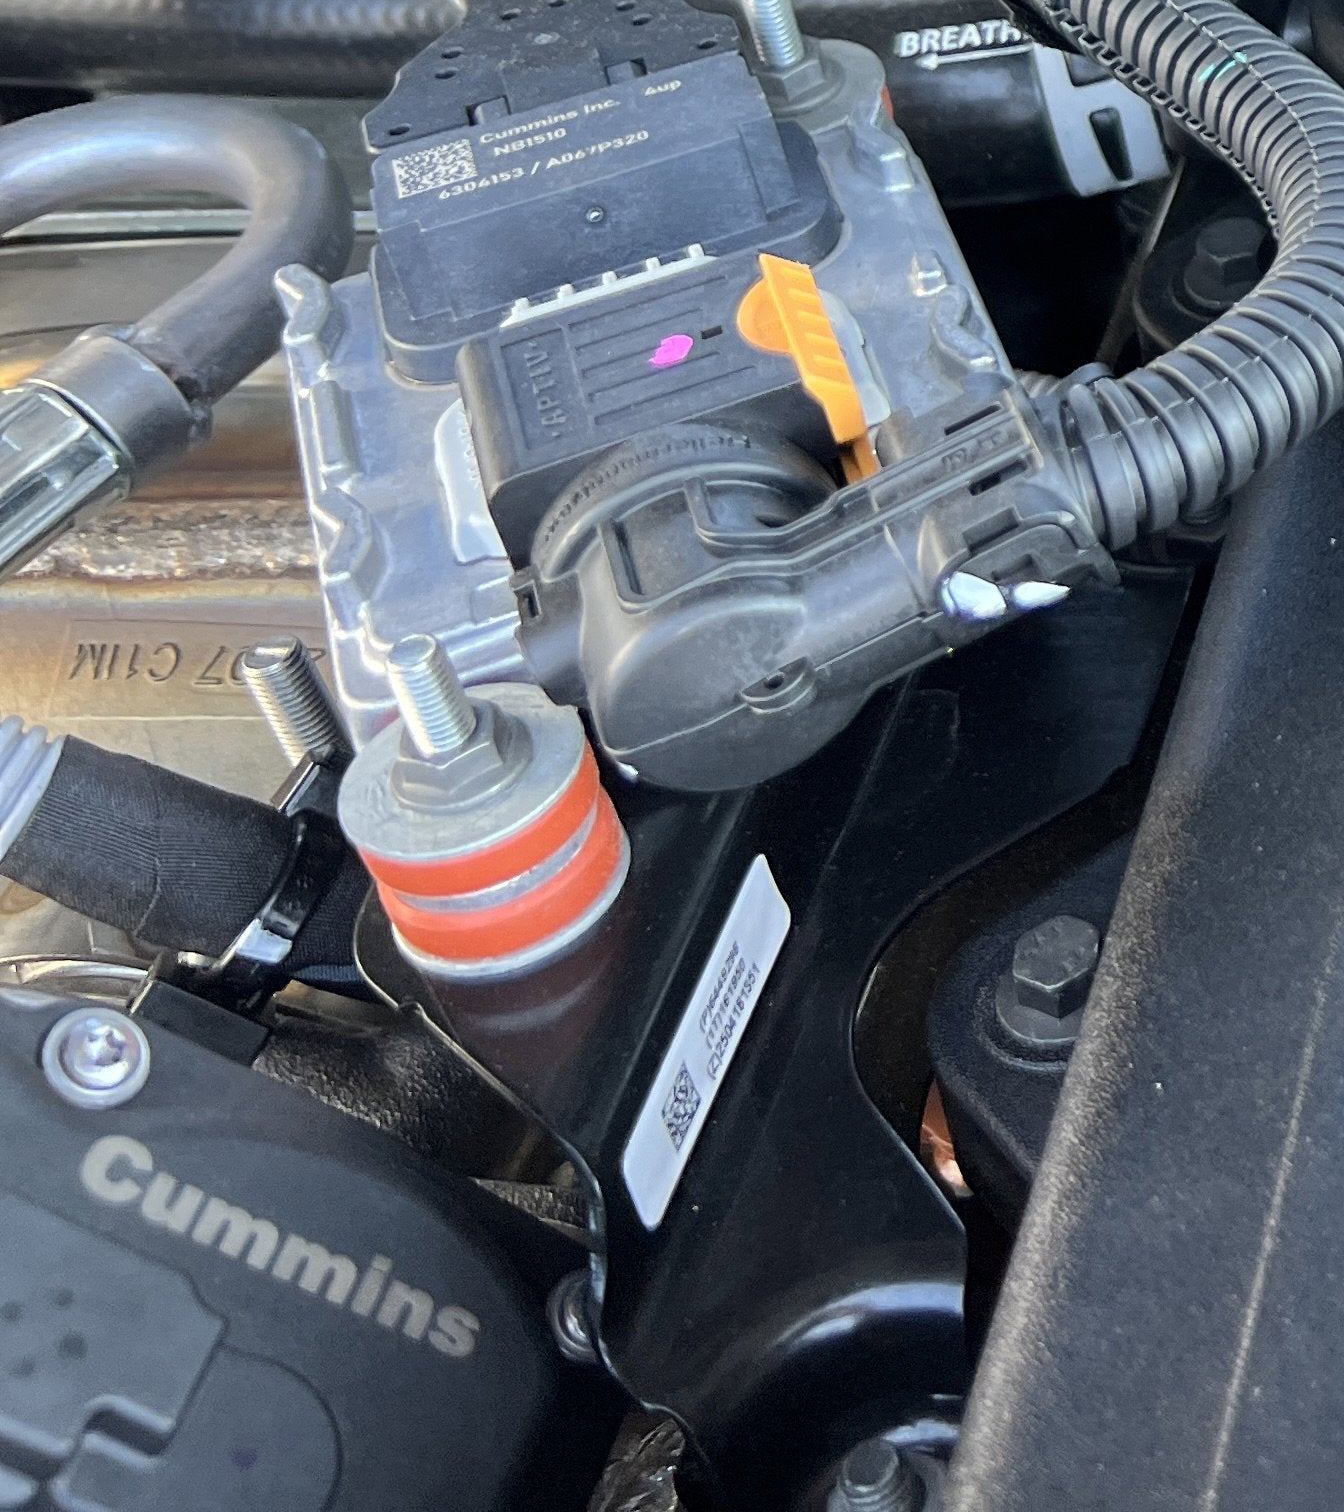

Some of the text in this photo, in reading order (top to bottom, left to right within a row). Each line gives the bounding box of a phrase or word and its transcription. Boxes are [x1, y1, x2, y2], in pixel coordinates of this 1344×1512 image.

[479, 110, 580, 145] Cummins
[583, 98, 621, 116] Inc.
[80, 1134, 481, 1359] Cummins
